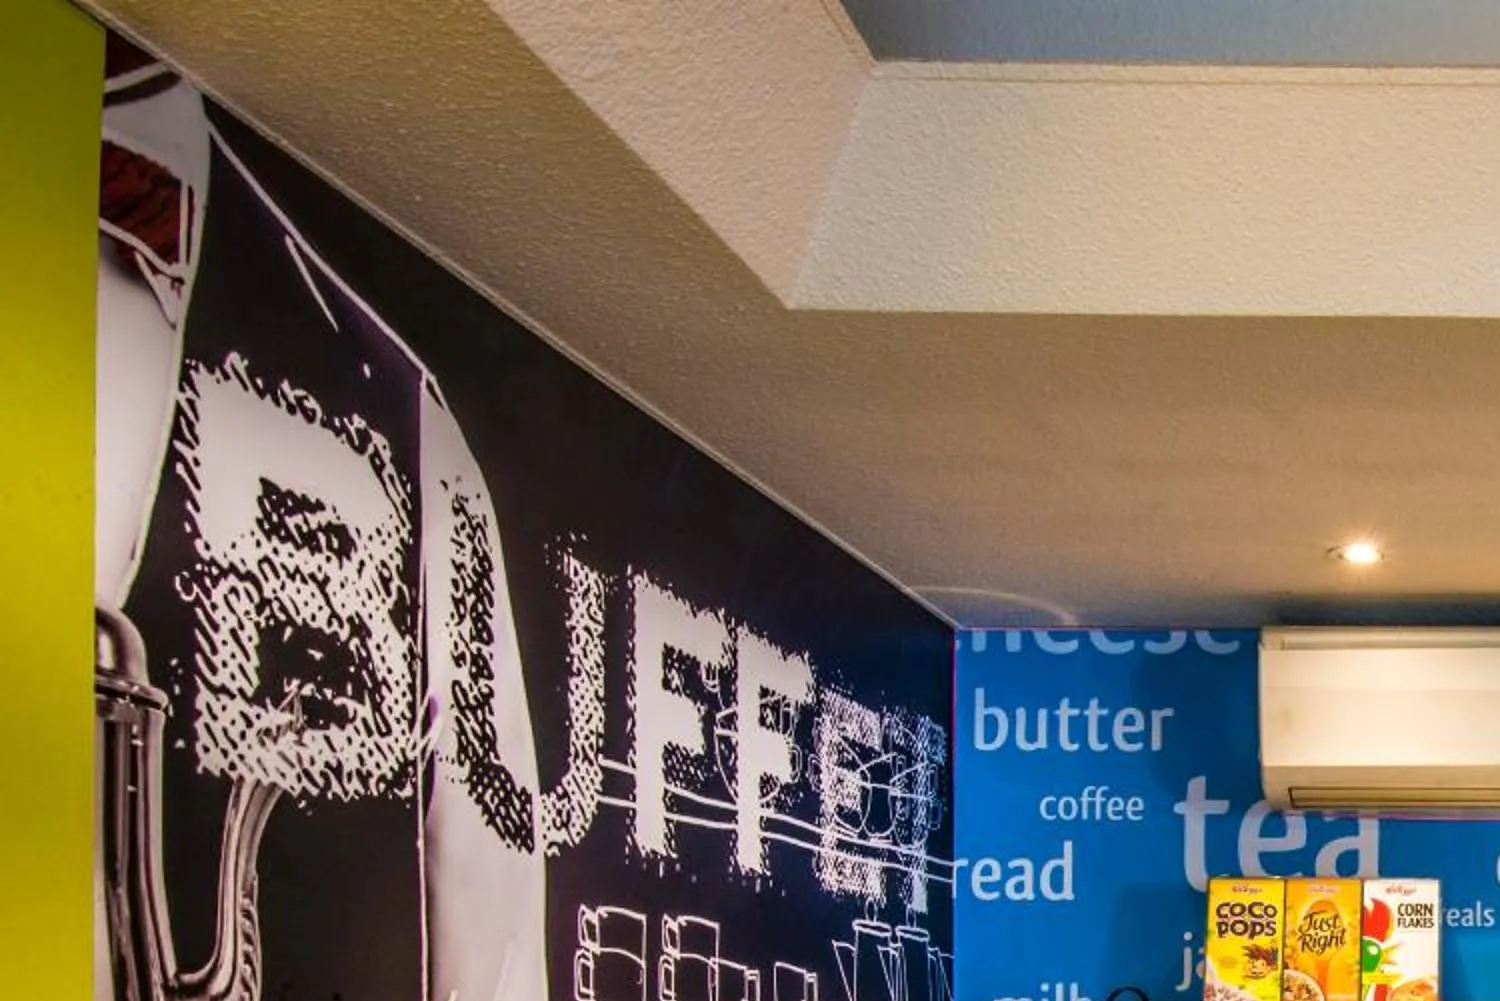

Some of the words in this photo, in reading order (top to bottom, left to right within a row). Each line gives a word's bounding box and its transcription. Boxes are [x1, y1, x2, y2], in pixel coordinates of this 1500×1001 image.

[972, 688, 1173, 752] butter
[1039, 786, 1145, 821] coffee
[1174, 775, 1381, 893] tea
[1216, 901, 1278, 919] COCO
[1397, 902, 1433, 917] CORN
[1444, 899, 1496, 928] eals
[1216, 919, 1277, 940] POPS
[1397, 917, 1435, 929] FLAKES
[1299, 930, 1348, 955] Right
